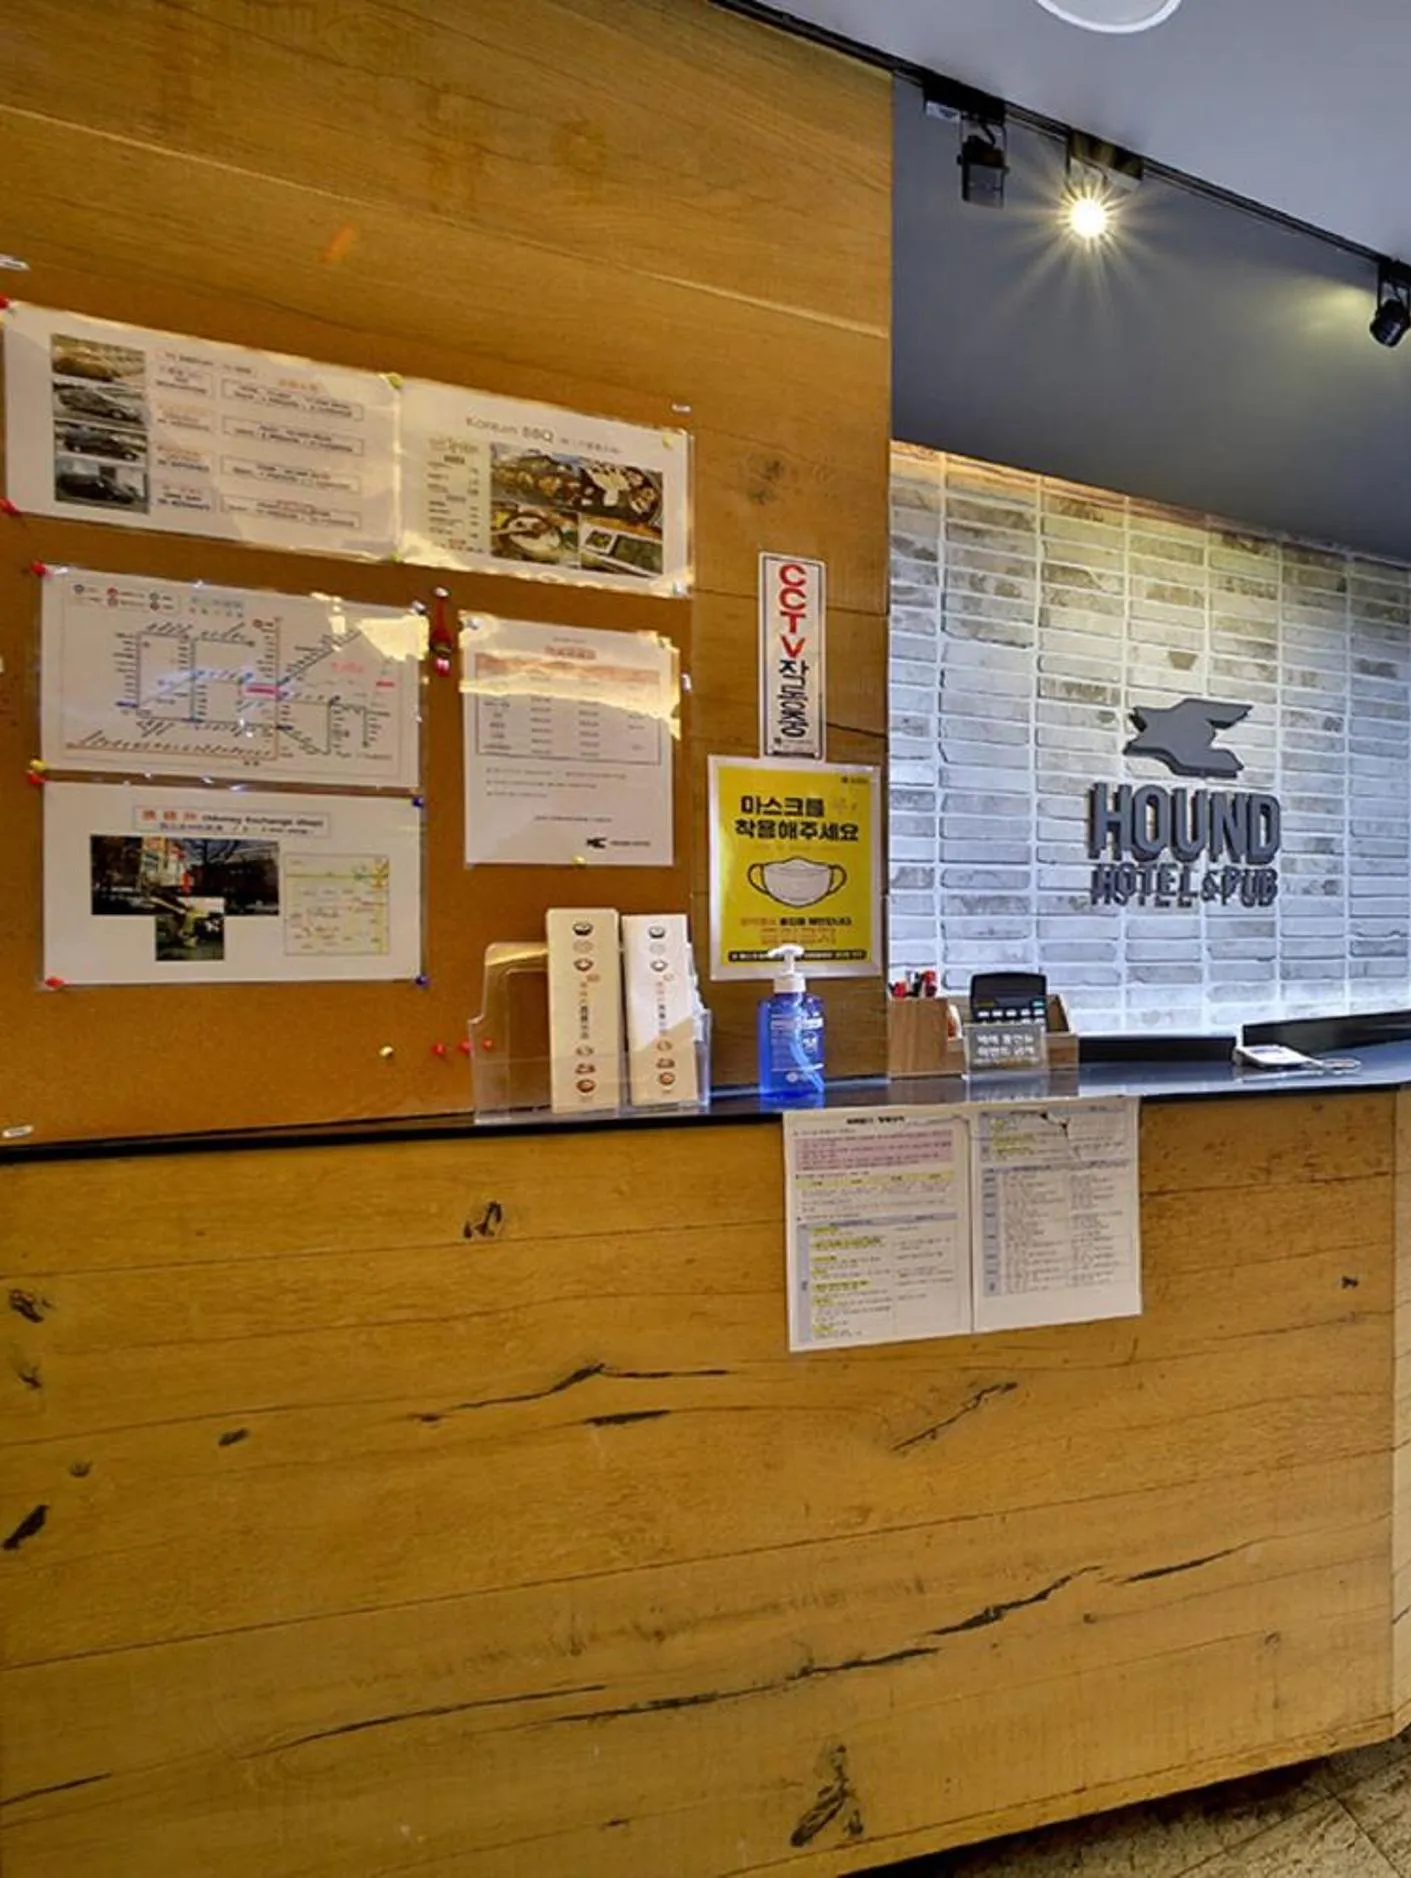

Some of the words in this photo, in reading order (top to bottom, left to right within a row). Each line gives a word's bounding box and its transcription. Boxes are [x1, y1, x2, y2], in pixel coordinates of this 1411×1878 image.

[740, 794, 825, 818] 마스크를
[734, 818, 860, 842] 착용해주세요
[1088, 782, 1281, 865] HOUND
